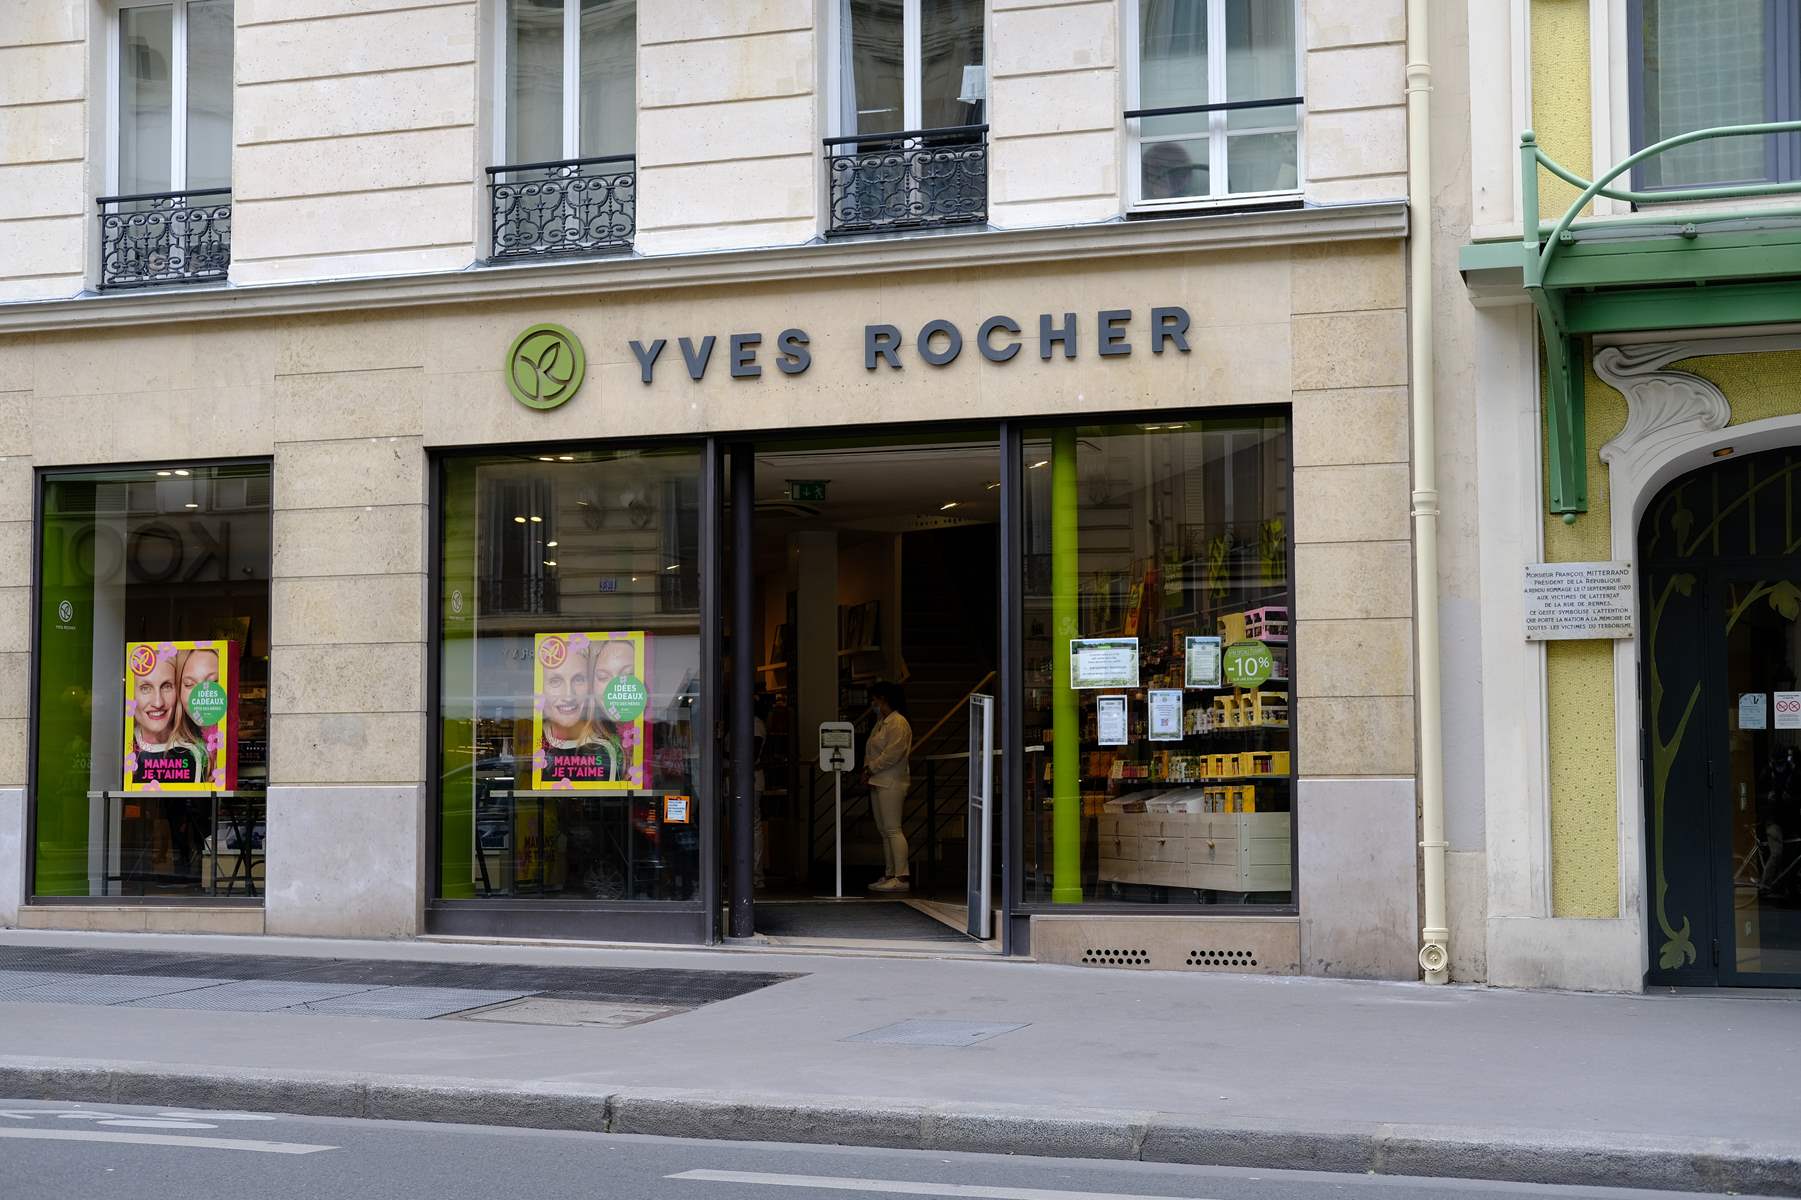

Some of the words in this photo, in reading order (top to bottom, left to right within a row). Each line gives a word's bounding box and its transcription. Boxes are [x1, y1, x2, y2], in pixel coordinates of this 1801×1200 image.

[628, 328, 811, 384] YVES
[865, 305, 1191, 370] ROCHER
[1227, 656, 1270, 677] -10%
[614, 683, 637, 692] IDÉES
[198, 689, 218, 698] IDÉES
[607, 692, 643, 700] CADEAUX
[144, 758, 189, 768] MAMANS
[554, 755, 602, 766] MAMANS
[142, 769, 154, 780] JE
[156, 769, 190, 780] T'AIME
[552, 766, 564, 778] JE
[567, 766, 604, 778] T'AIME
